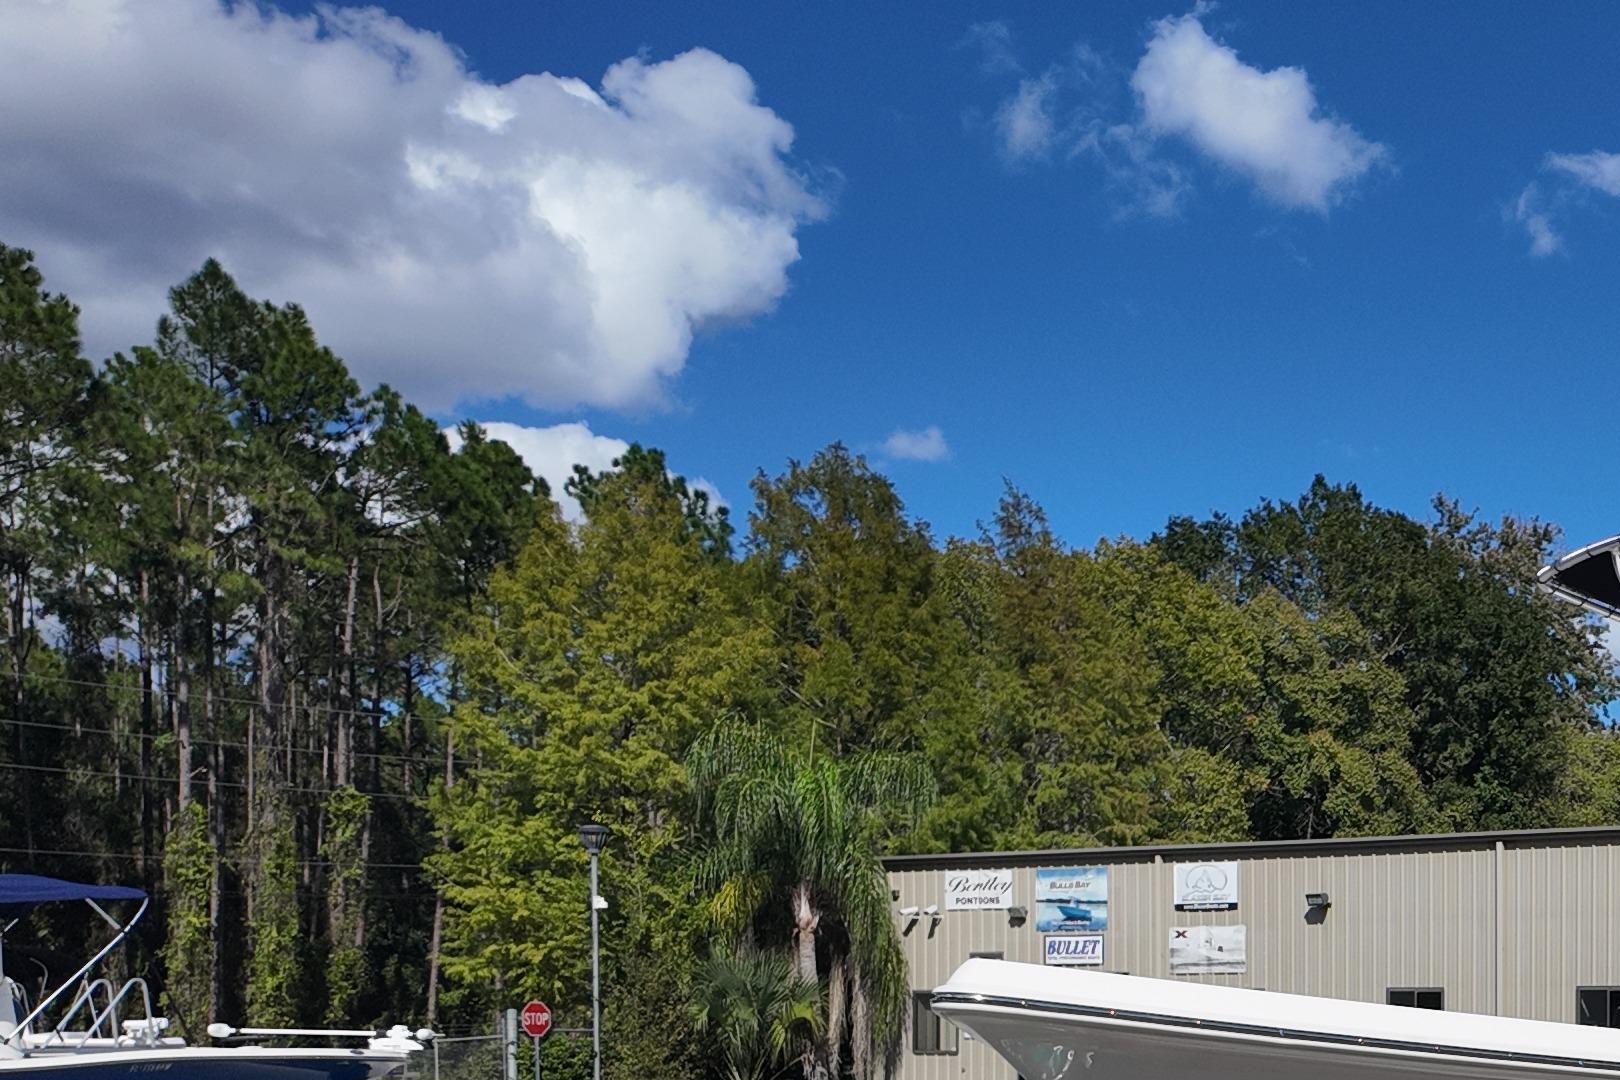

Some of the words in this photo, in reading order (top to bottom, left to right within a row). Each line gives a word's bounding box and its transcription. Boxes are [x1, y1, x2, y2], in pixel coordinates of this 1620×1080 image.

[948, 876, 1012, 895] Bentley
[1075, 881, 1091, 889] BAY
[1047, 940, 1100, 955] BULLET
[524, 1012, 549, 1025] STOP
